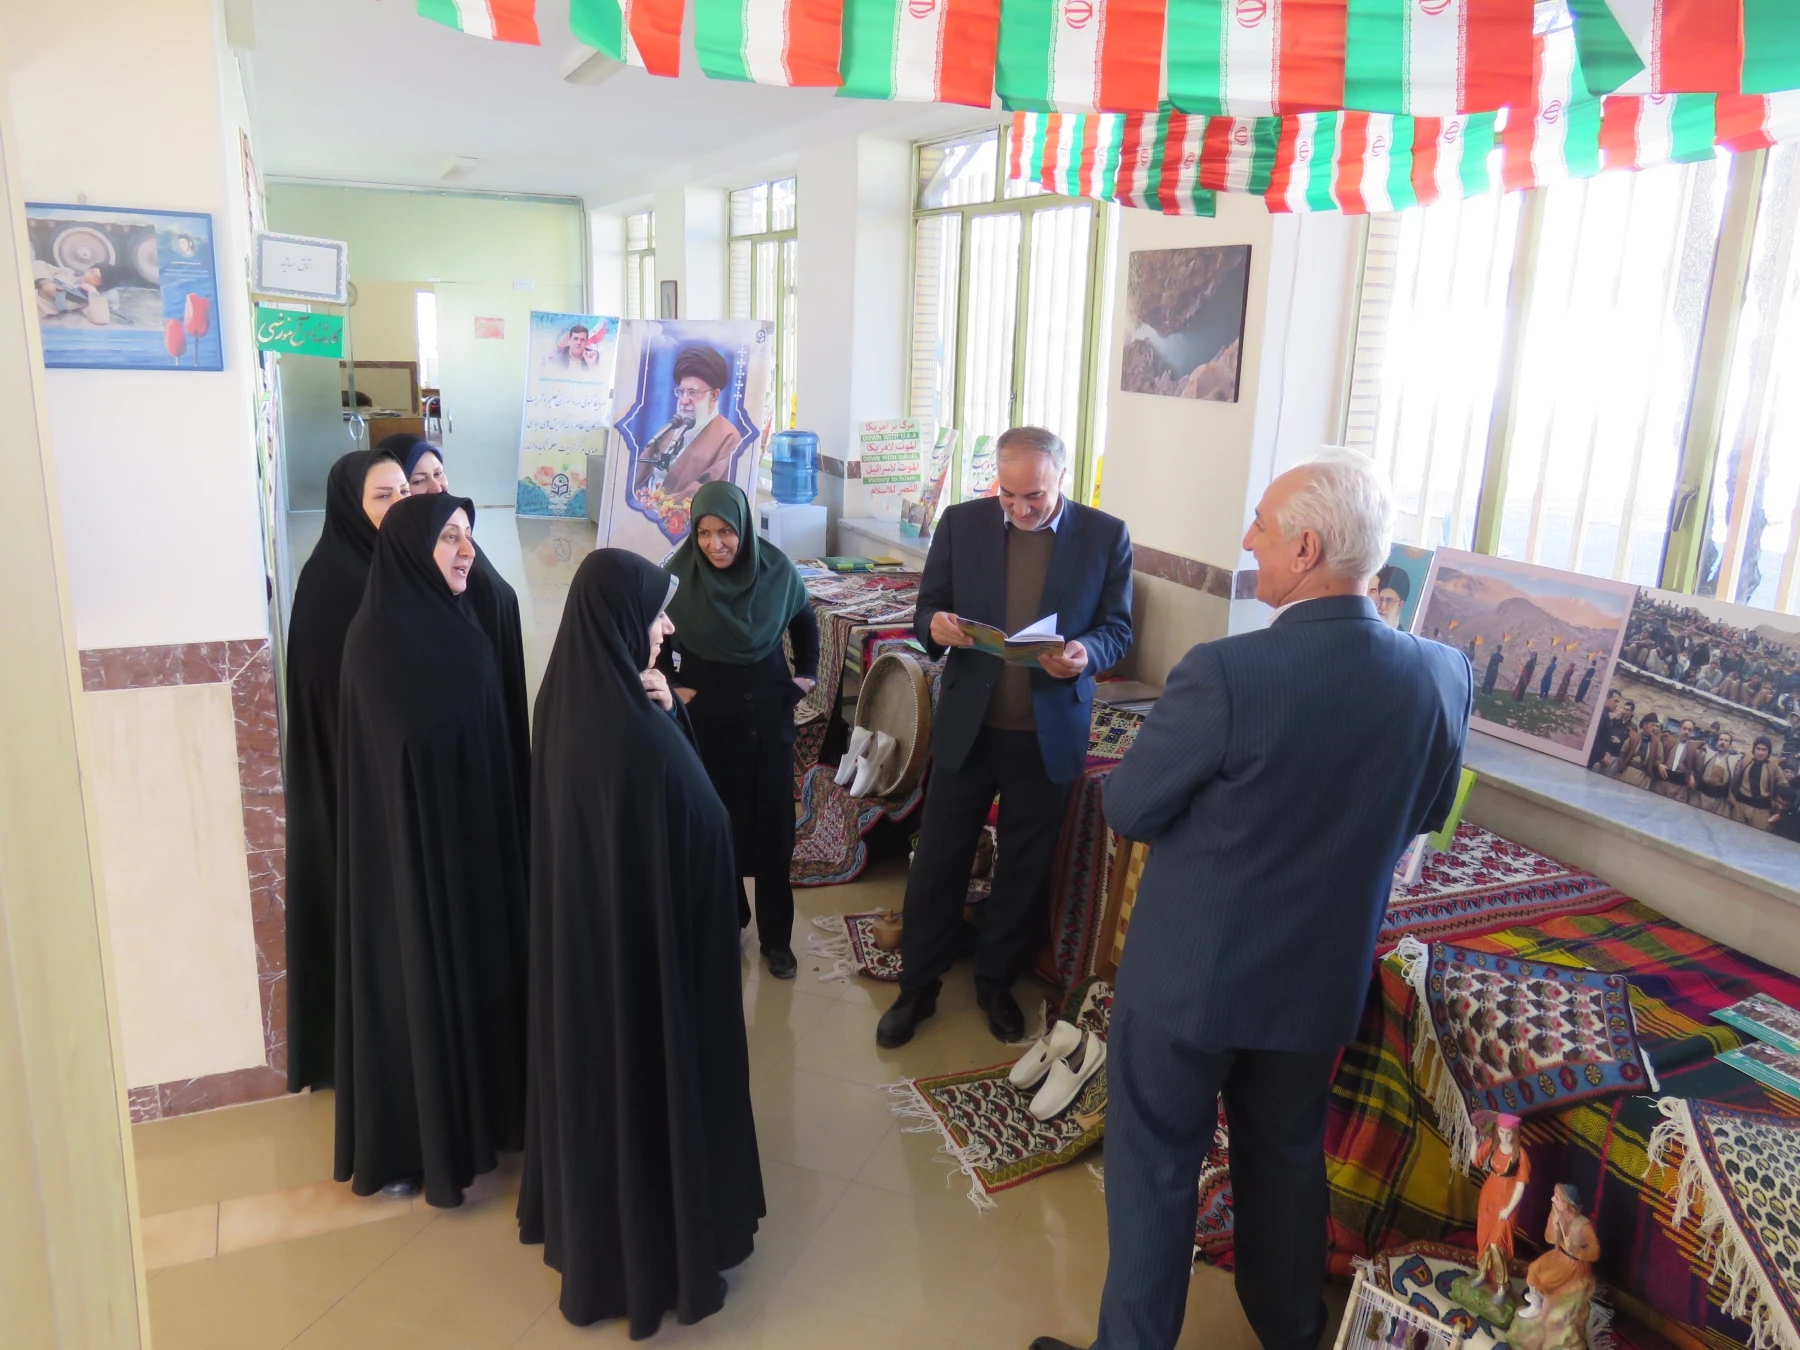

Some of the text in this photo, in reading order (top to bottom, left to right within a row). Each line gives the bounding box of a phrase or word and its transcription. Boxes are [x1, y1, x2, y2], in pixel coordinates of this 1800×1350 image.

[257, 312, 310, 343] آموزشی
[890, 424, 898, 432] بر
[899, 420, 915, 431] مرگ
